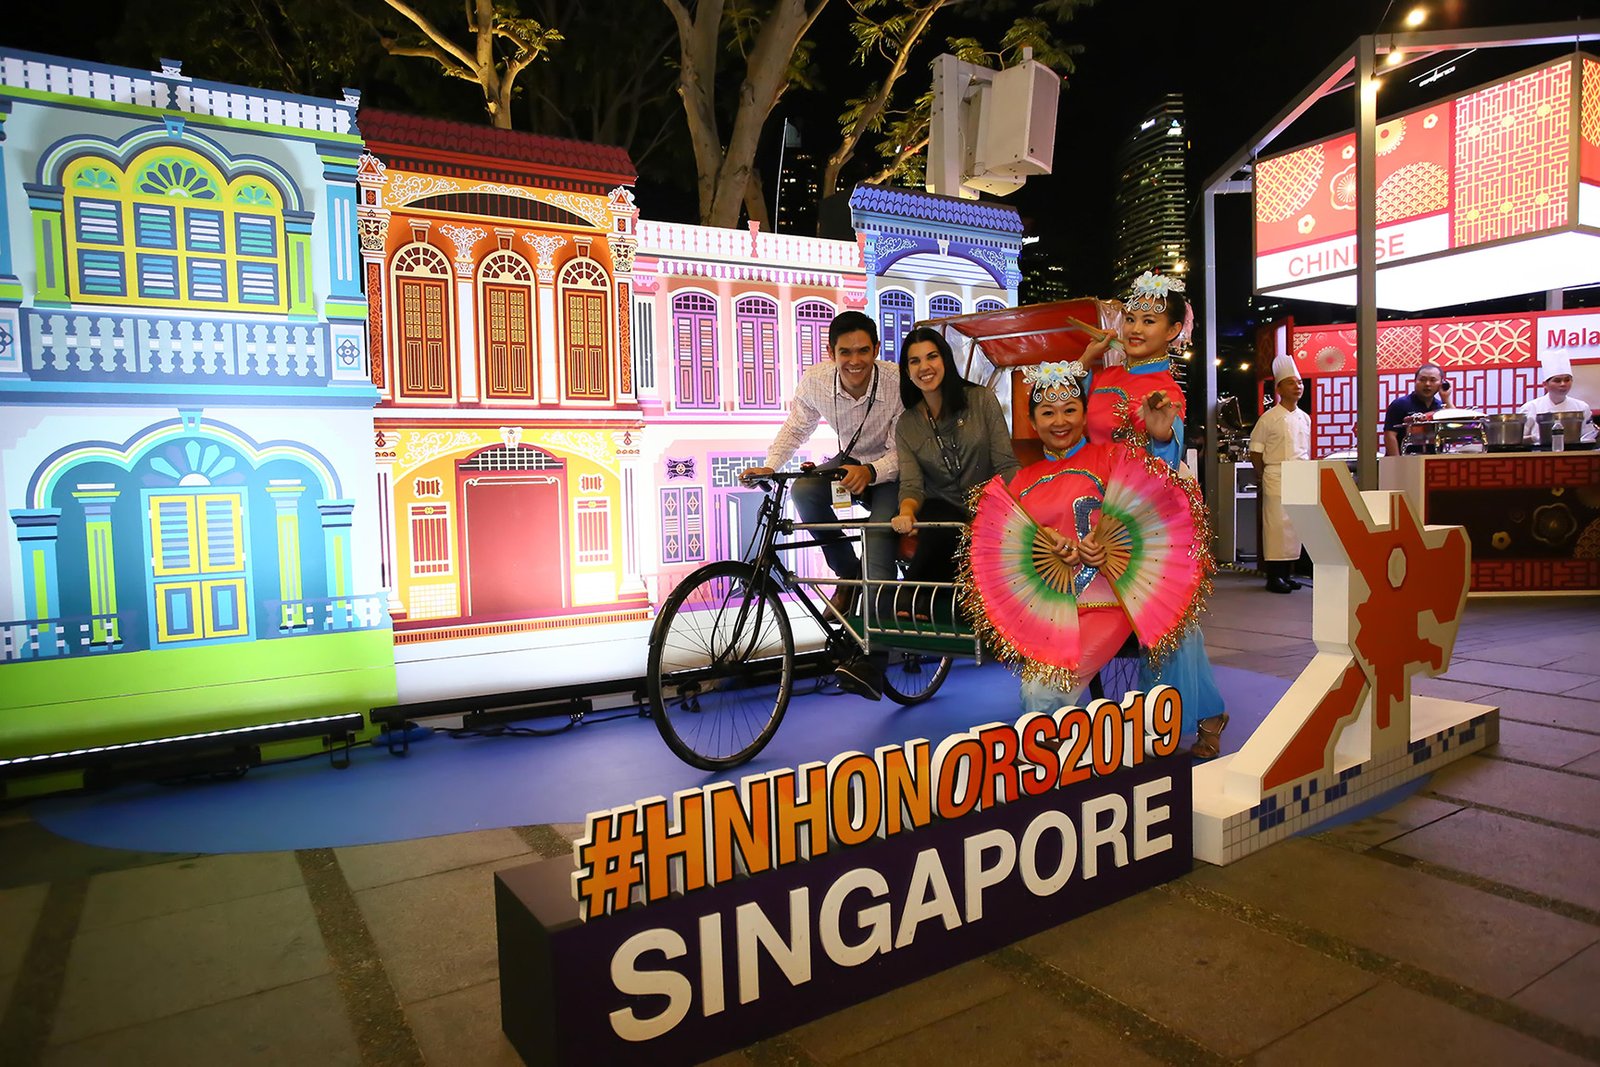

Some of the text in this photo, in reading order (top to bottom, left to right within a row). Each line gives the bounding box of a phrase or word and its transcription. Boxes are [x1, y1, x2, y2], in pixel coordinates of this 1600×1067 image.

[1547, 328, 1600, 347] Mala
[574, 685, 1183, 920] #HNHONORS2019
[609, 776, 1173, 1042] SINGAPORE
